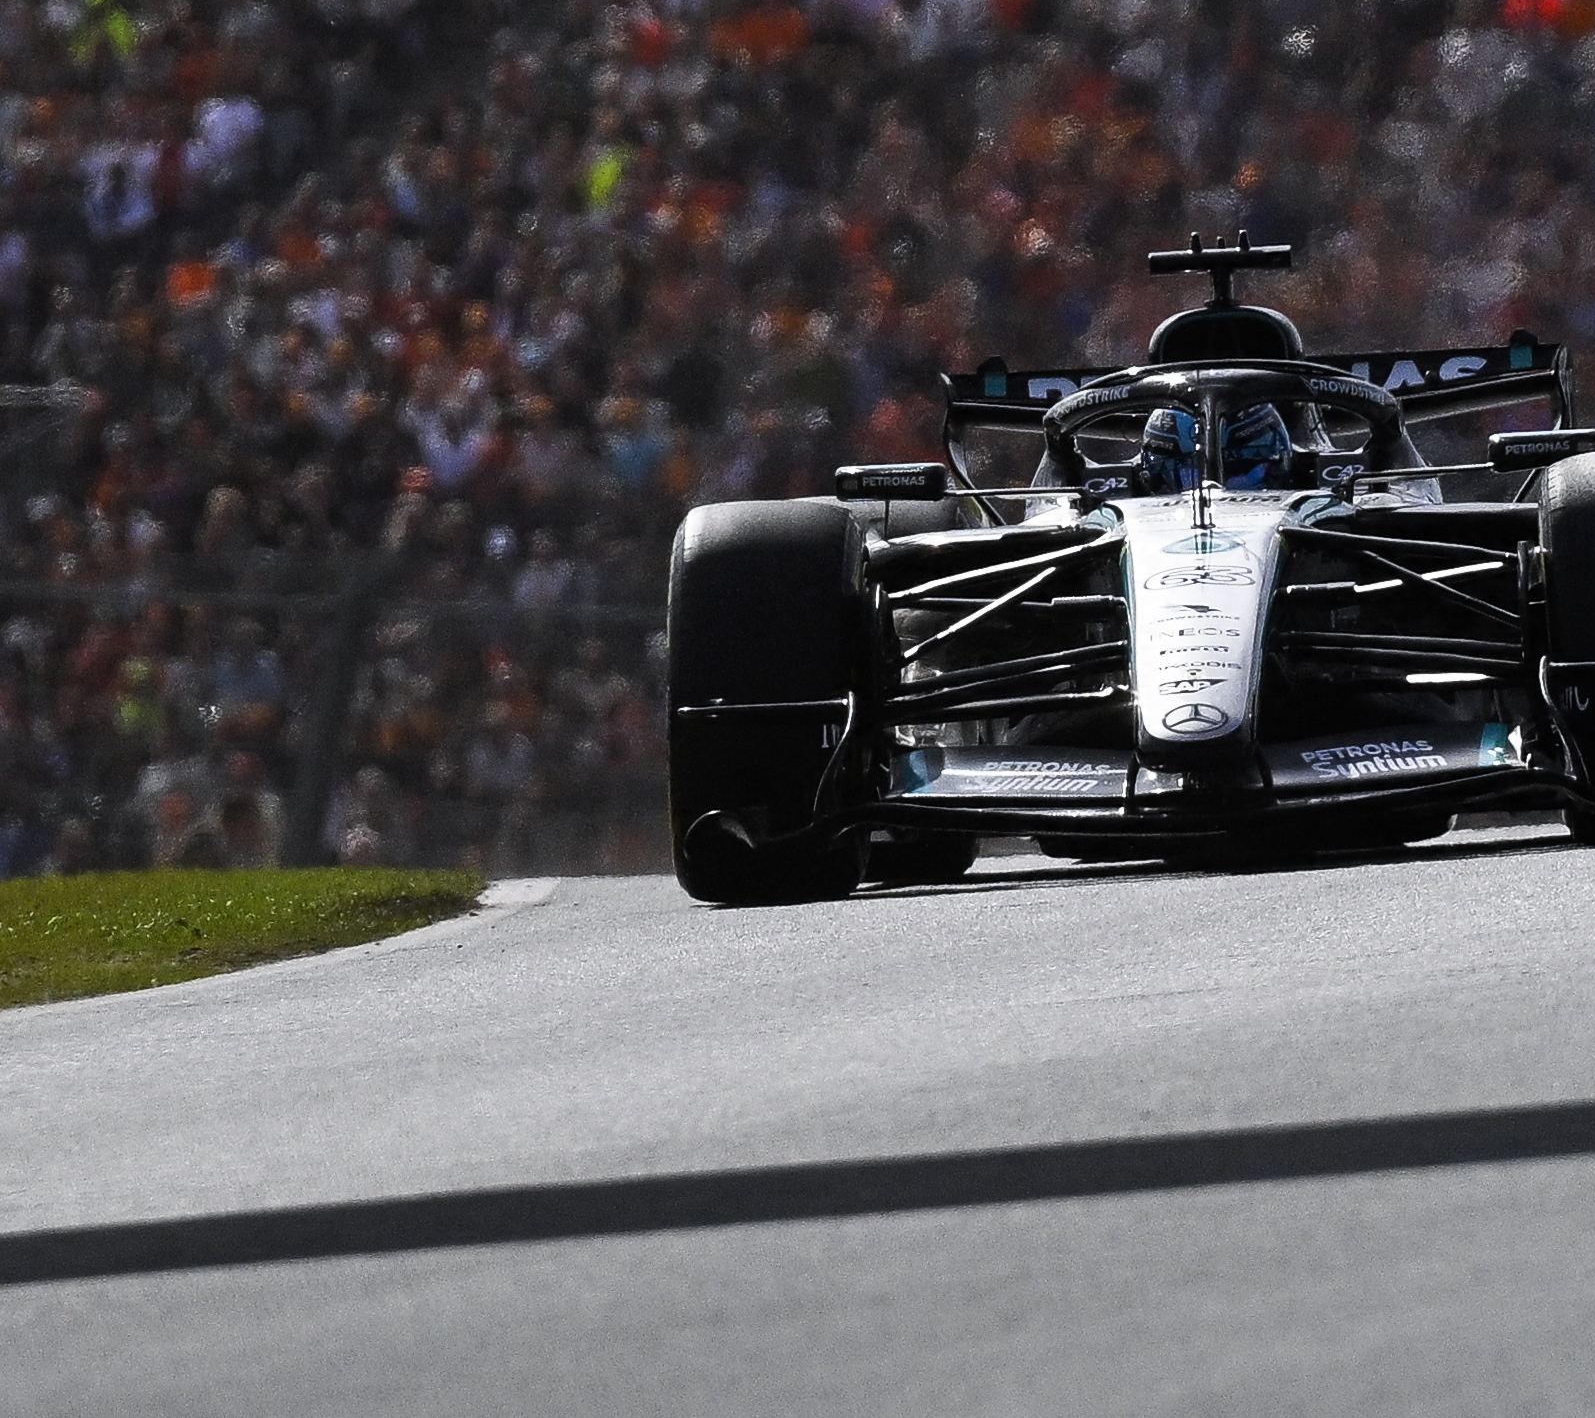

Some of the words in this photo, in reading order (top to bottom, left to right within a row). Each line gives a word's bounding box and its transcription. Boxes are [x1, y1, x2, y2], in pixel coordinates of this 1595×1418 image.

[1310, 378, 1386, 405] CROWDST
[1504, 440, 1571, 456] PETRONAS
[861, 476, 926, 486] PETRONAS
[1143, 565, 1256, 590] 63
[1149, 627, 1241, 642] INEOS
[1301, 740, 1433, 763] PETRONAS
[983, 761, 1111, 775] PETRONAS
[1311, 755, 1448, 779] Syntium
